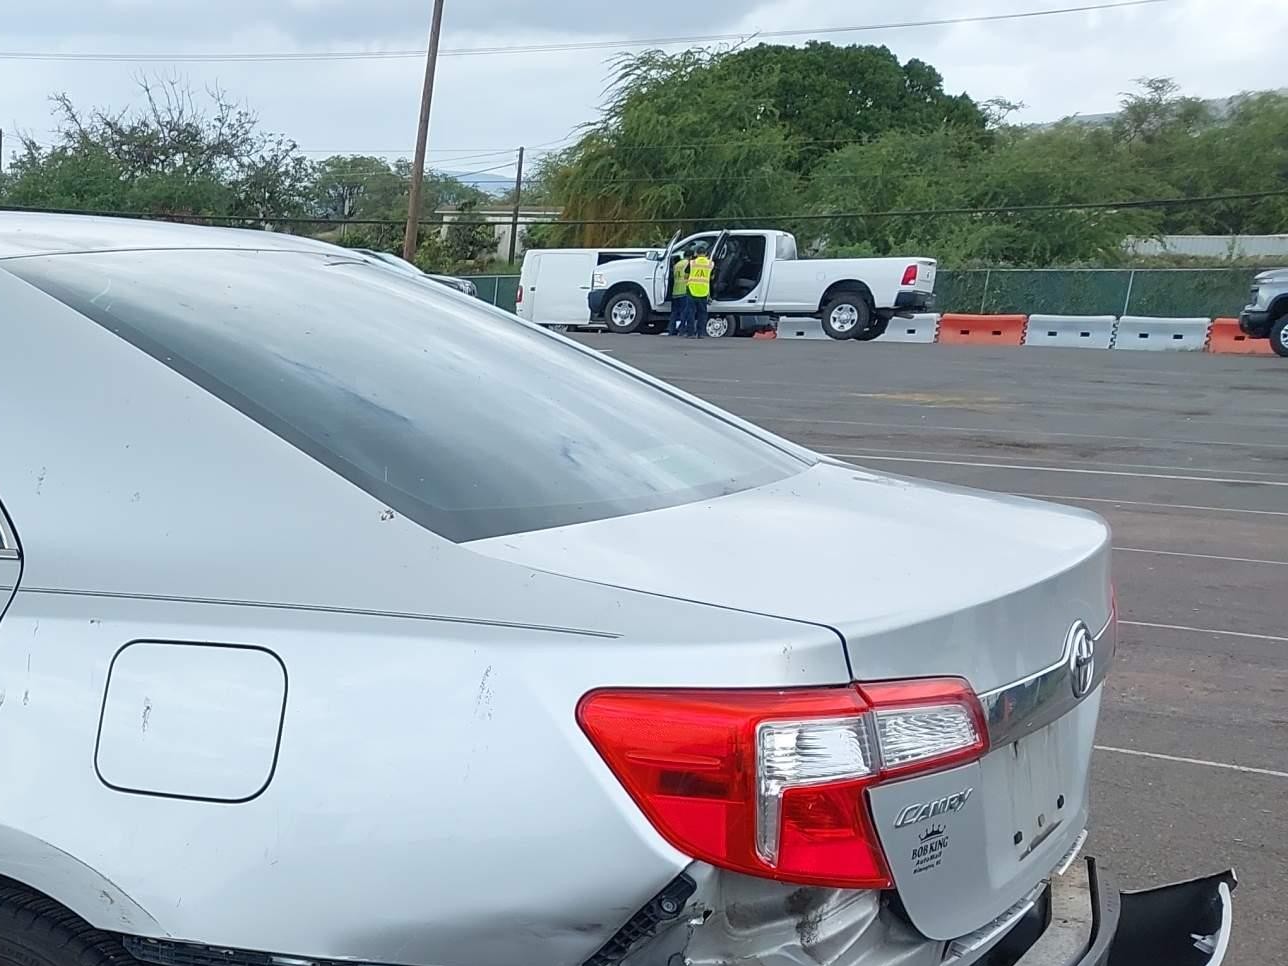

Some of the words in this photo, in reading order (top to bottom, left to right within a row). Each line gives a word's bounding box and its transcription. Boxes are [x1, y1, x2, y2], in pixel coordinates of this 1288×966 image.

[894, 787, 973, 828] CAMRY
[912, 845, 928, 860] BOB
[929, 836, 949, 854] KING
